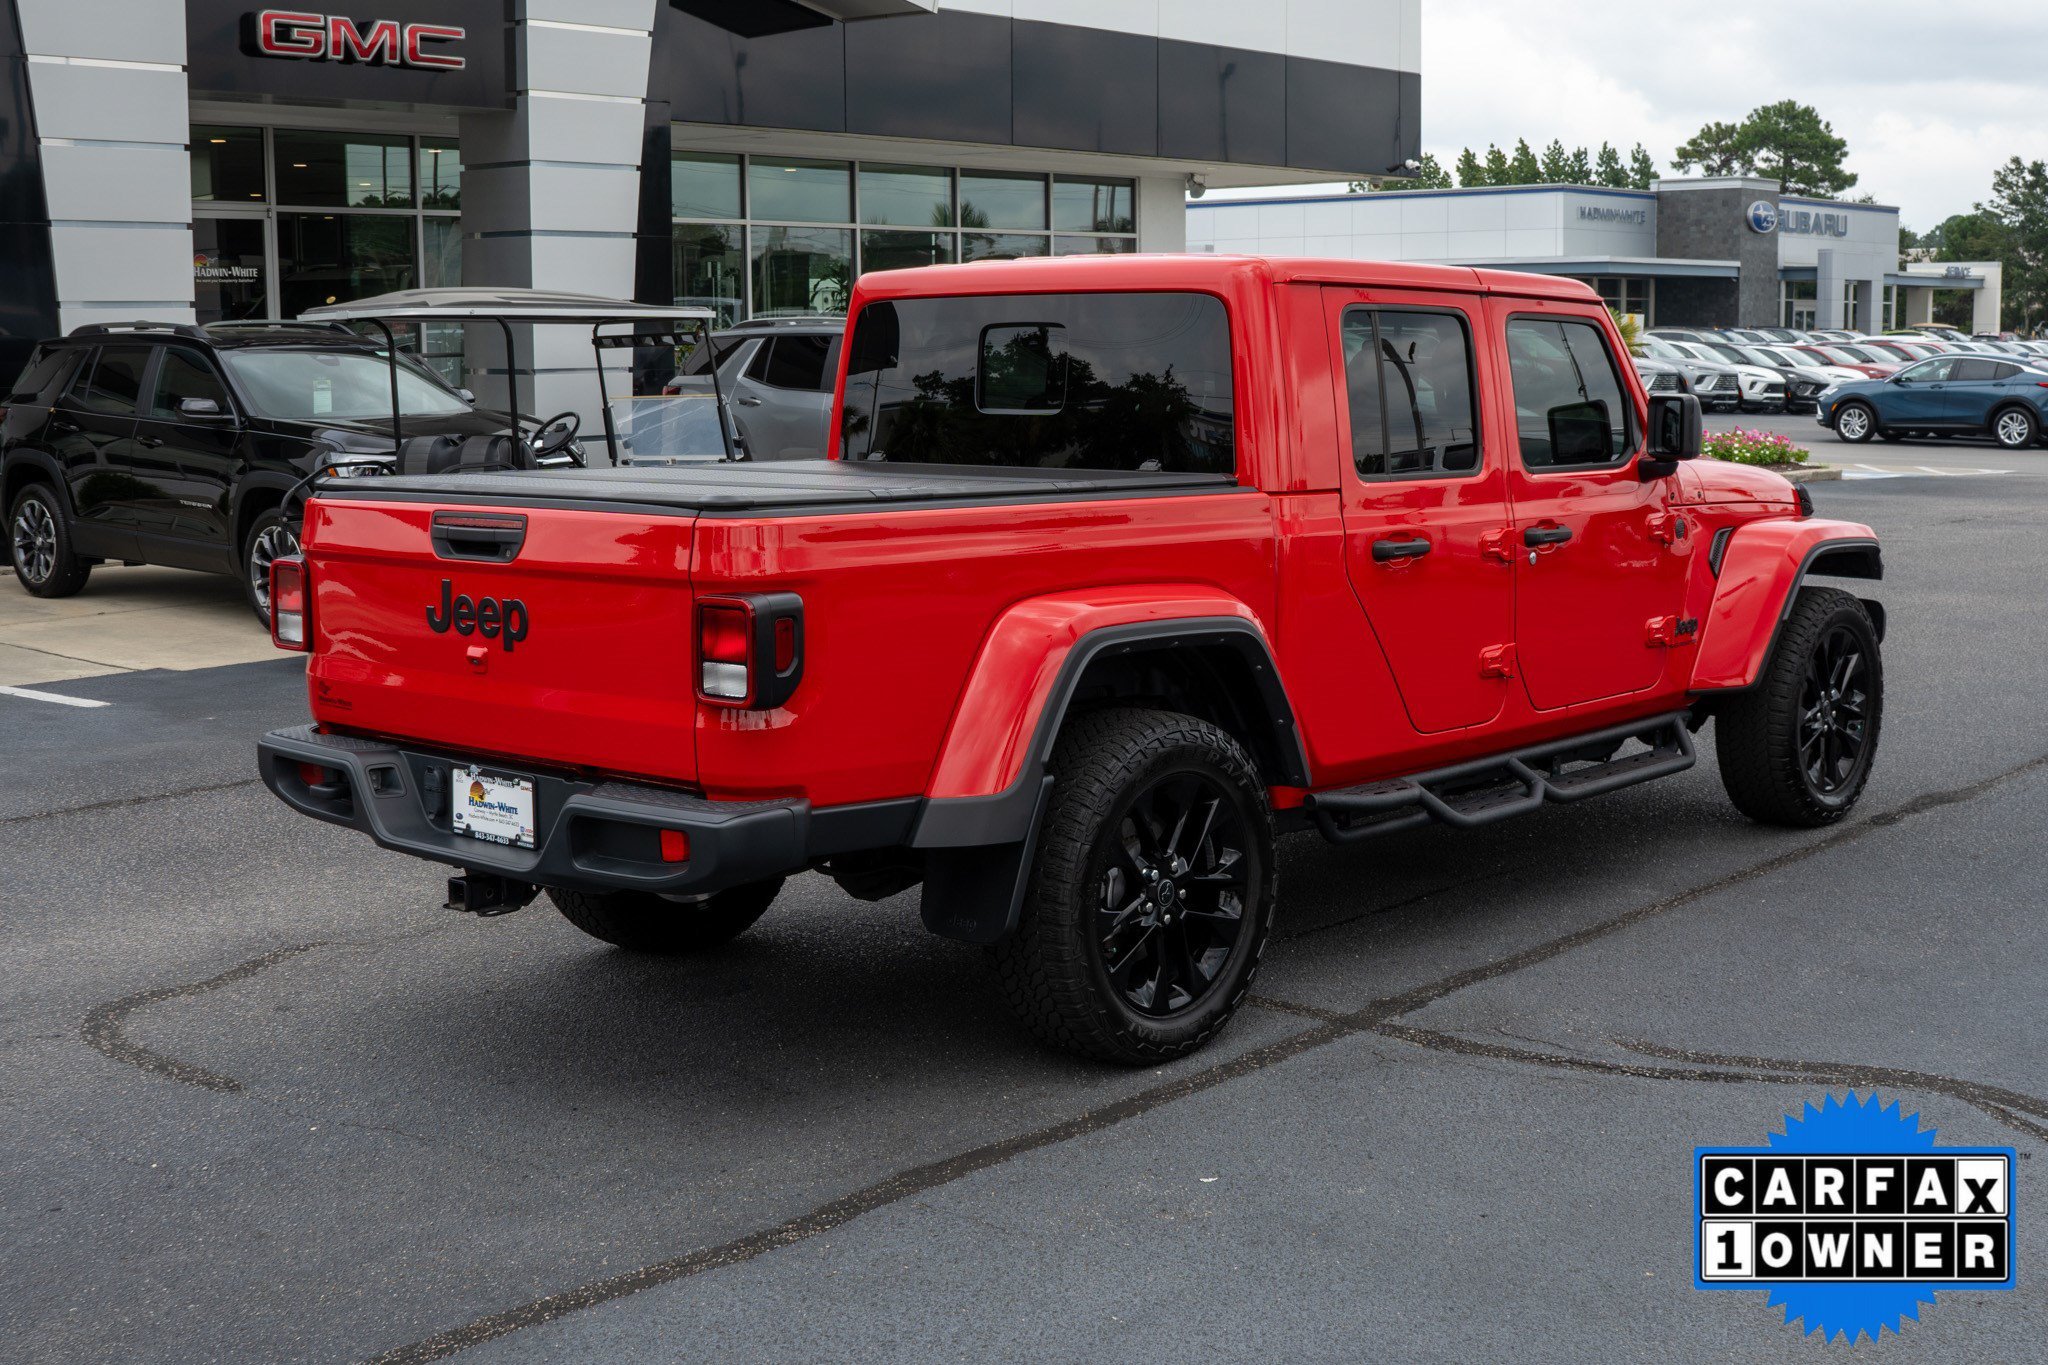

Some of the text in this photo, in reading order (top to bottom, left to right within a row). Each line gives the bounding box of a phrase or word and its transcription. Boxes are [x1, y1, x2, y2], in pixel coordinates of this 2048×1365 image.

[256, 9, 465, 71] GMC
[426, 579, 528, 652] Jeep
[1674, 616, 1698, 637] Jeep
[468, 796, 519, 815] HADWIN-WHITE
[475, 831, 510, 845] 843-347-4633
